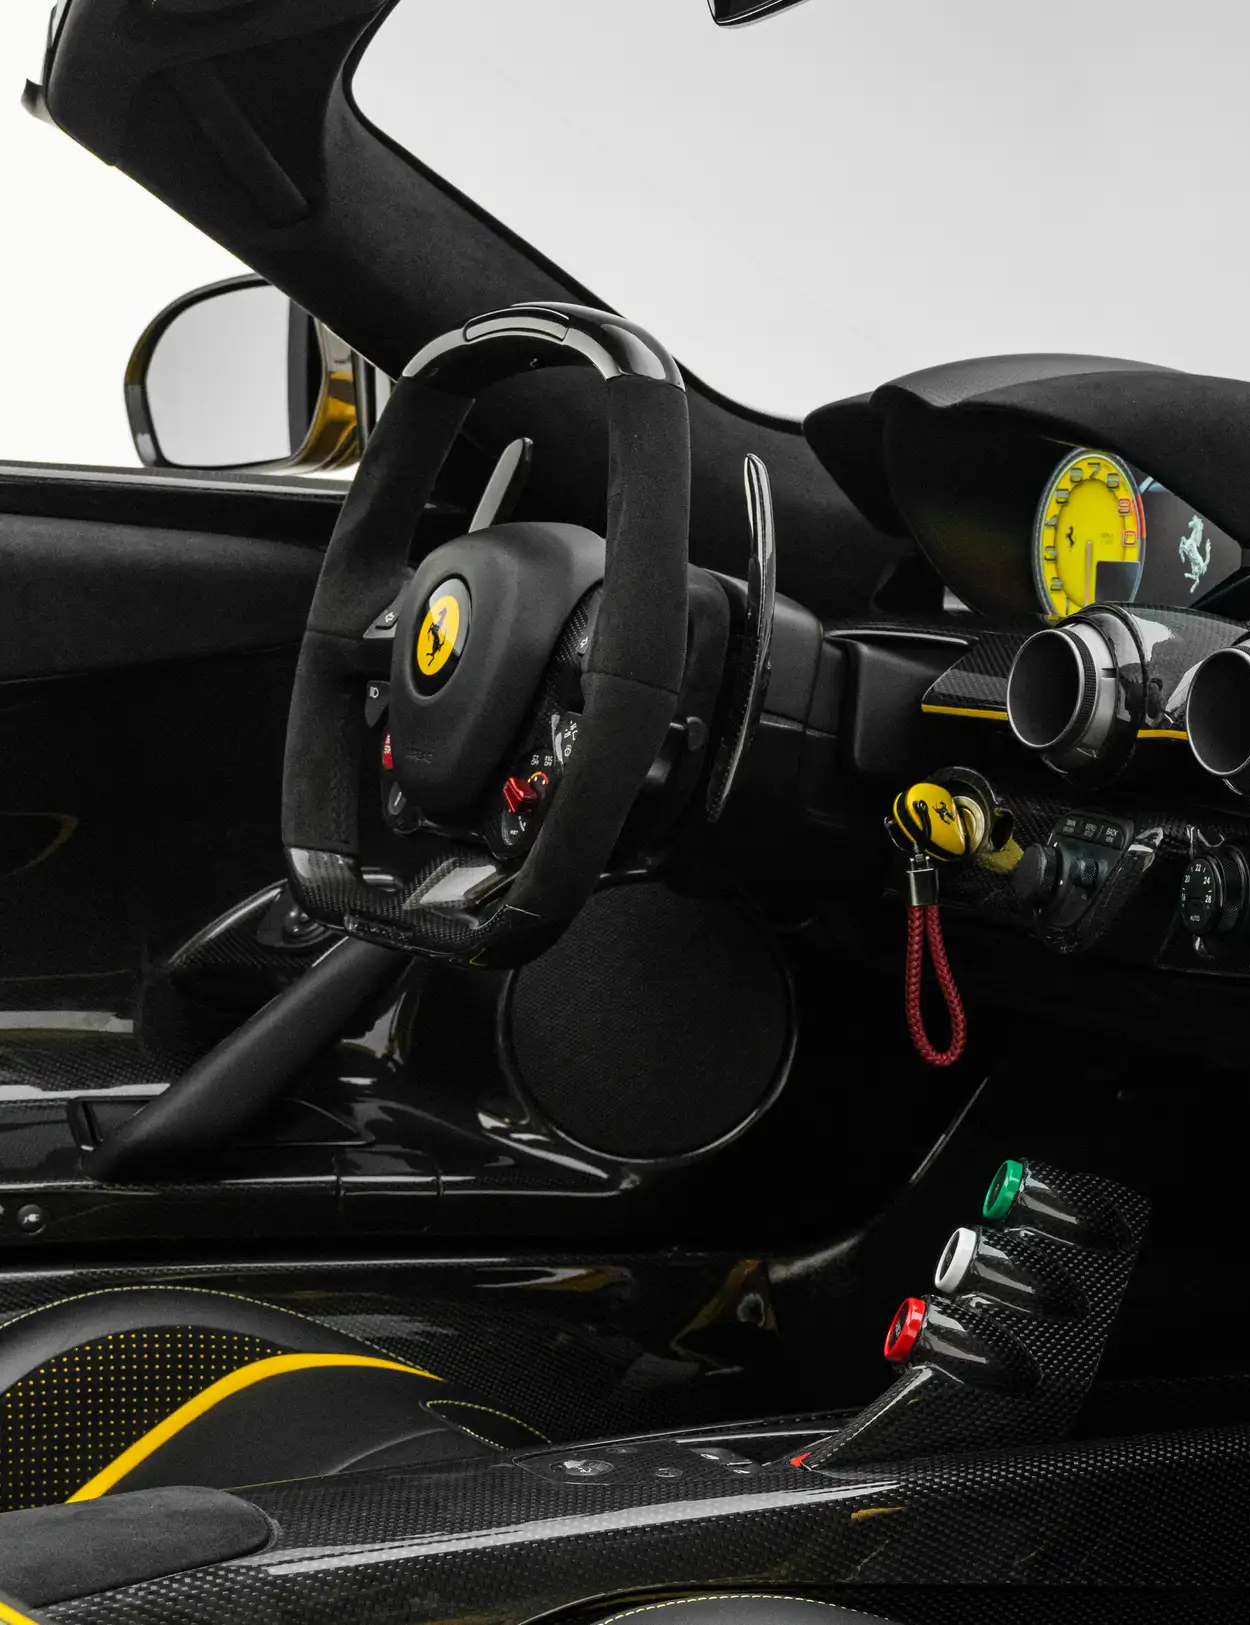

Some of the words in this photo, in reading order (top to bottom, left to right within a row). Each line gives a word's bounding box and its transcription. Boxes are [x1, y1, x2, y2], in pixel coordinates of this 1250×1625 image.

[1087, 462, 1101, 480] 7
[1194, 863, 1202, 872] 22
[1184, 874, 1191, 884] 20
[1202, 876, 1211, 885] 24
